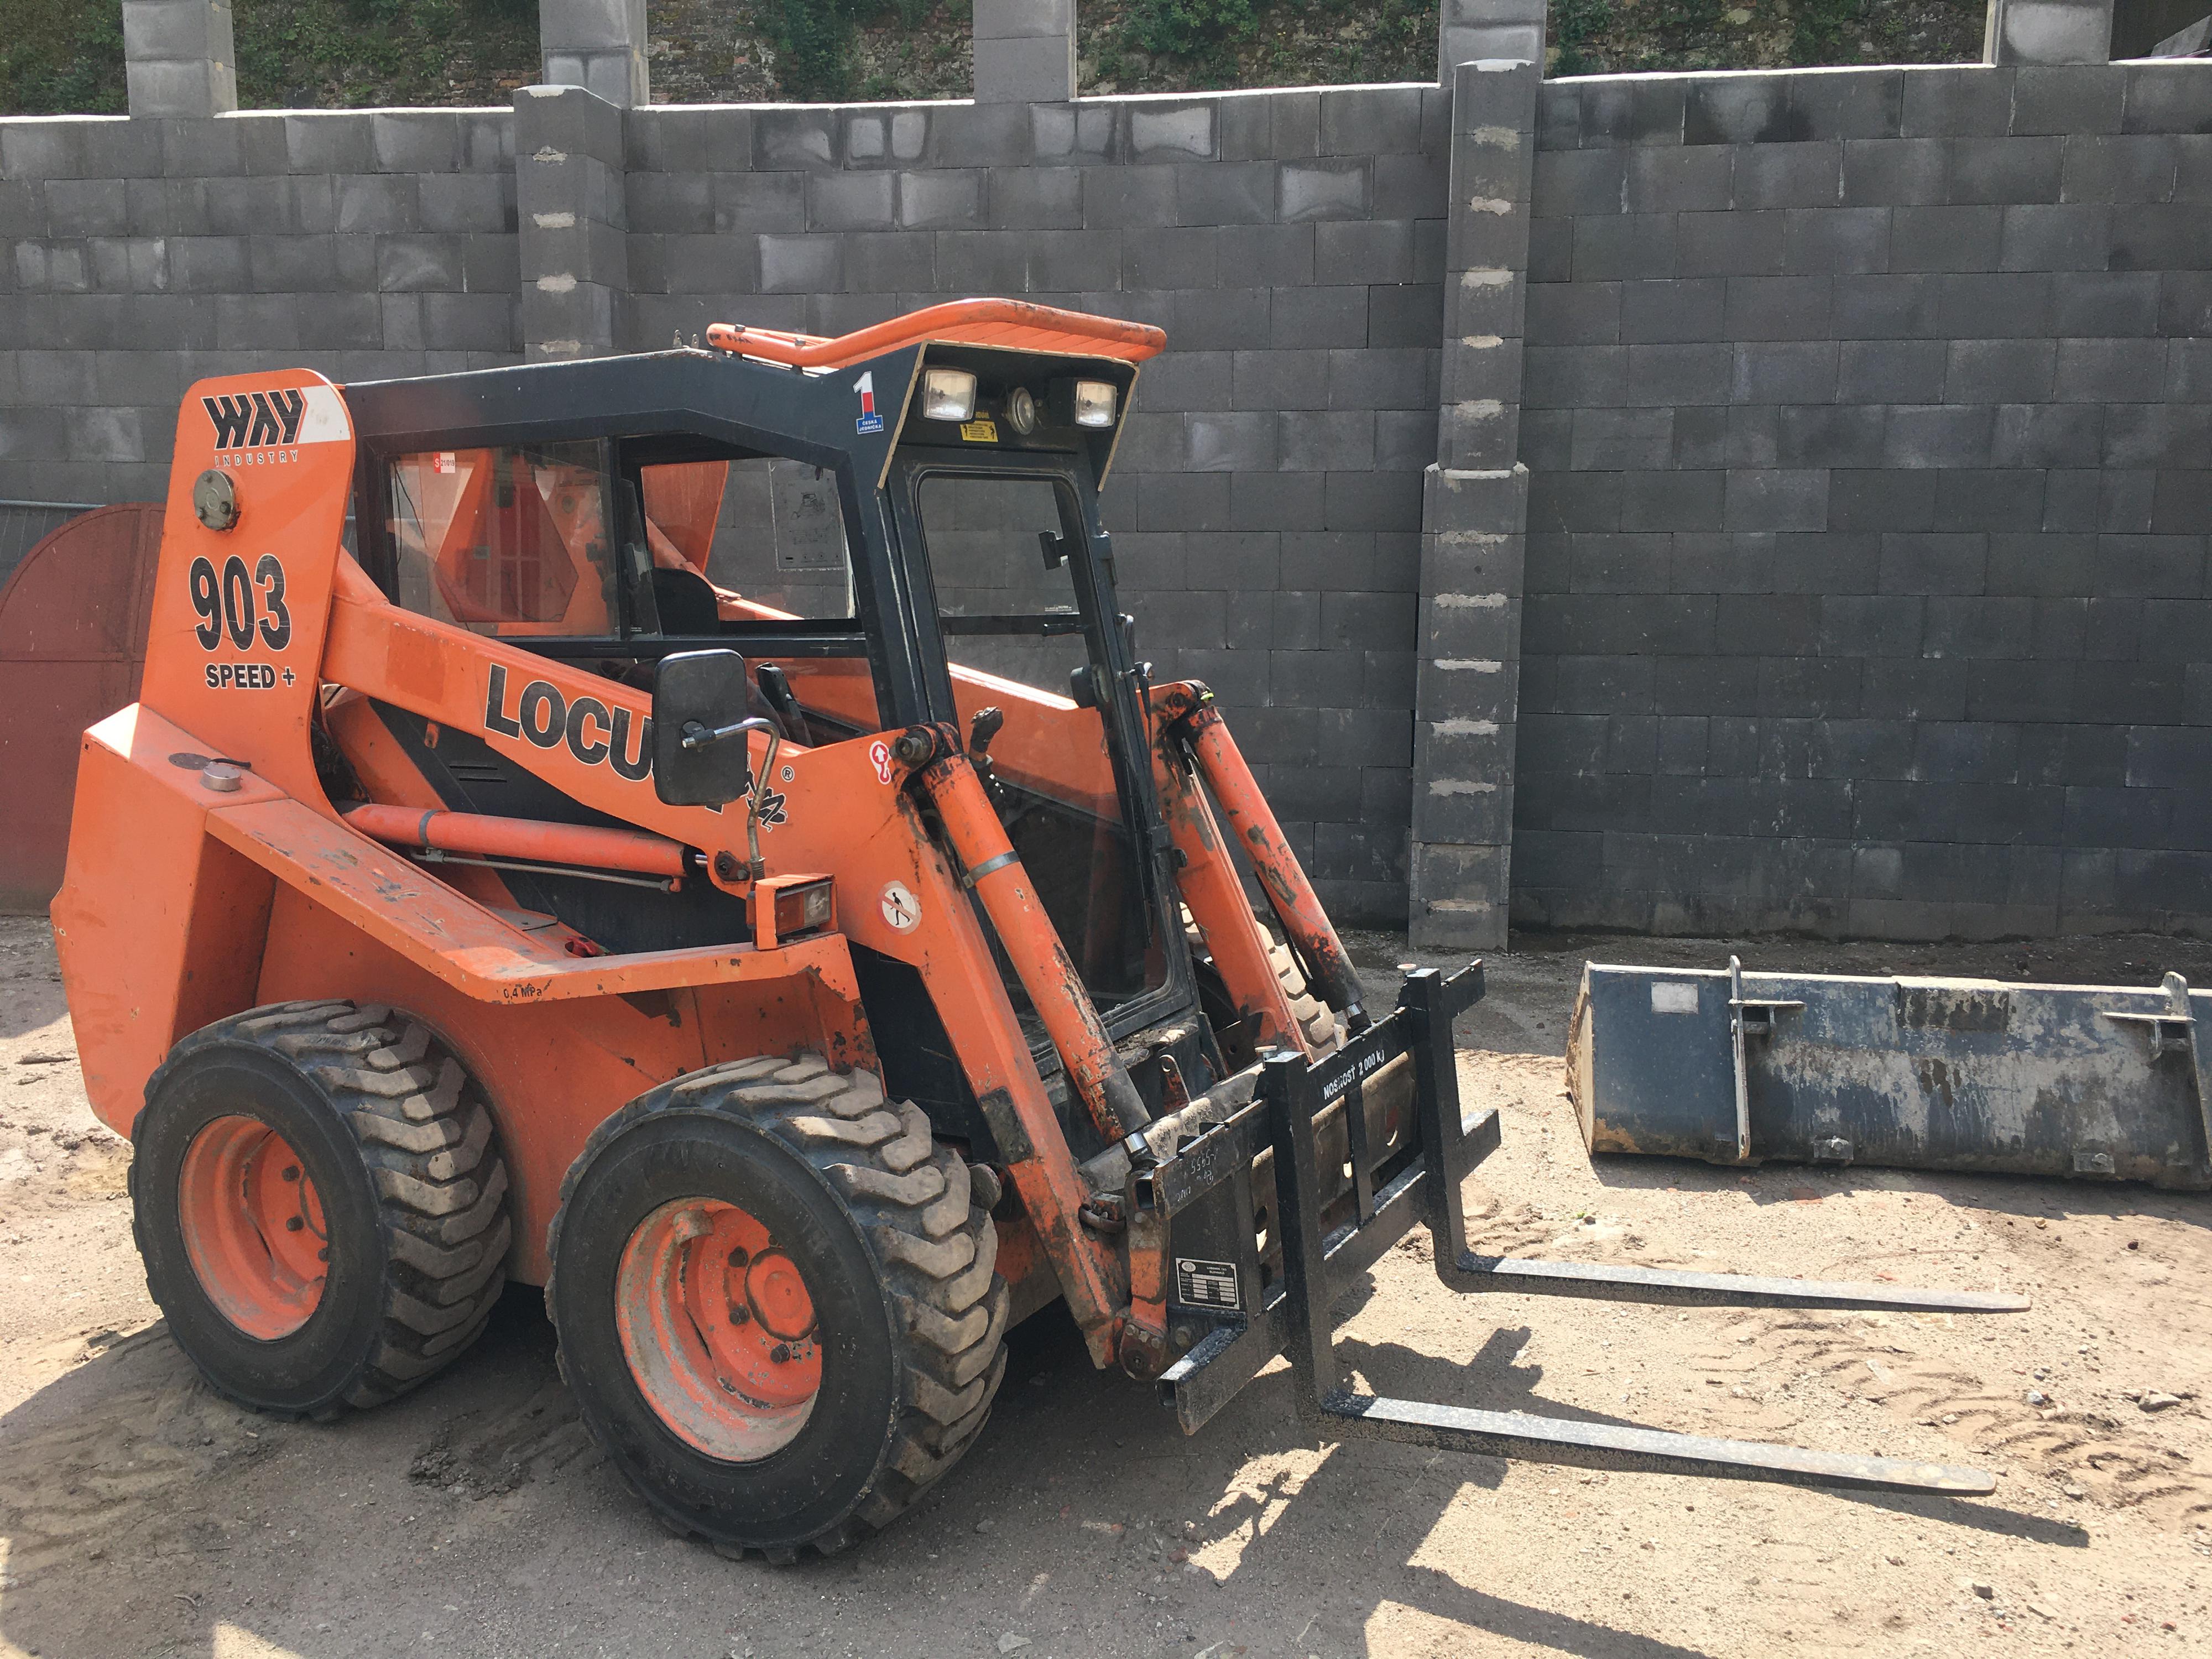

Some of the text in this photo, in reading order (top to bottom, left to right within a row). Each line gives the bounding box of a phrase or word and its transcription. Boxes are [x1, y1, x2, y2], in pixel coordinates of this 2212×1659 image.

[200, 388, 305, 451] WAY
[214, 449, 298, 468] INDUSTRY
[435, 458, 440, 468] S
[189, 553, 291, 652] 903
[205, 662, 276, 690] SPEED
[484, 662, 723, 815] LOCU
[503, 986, 542, 1000] 0,4 MPa
[1364, 1053, 1376, 1071] 000
